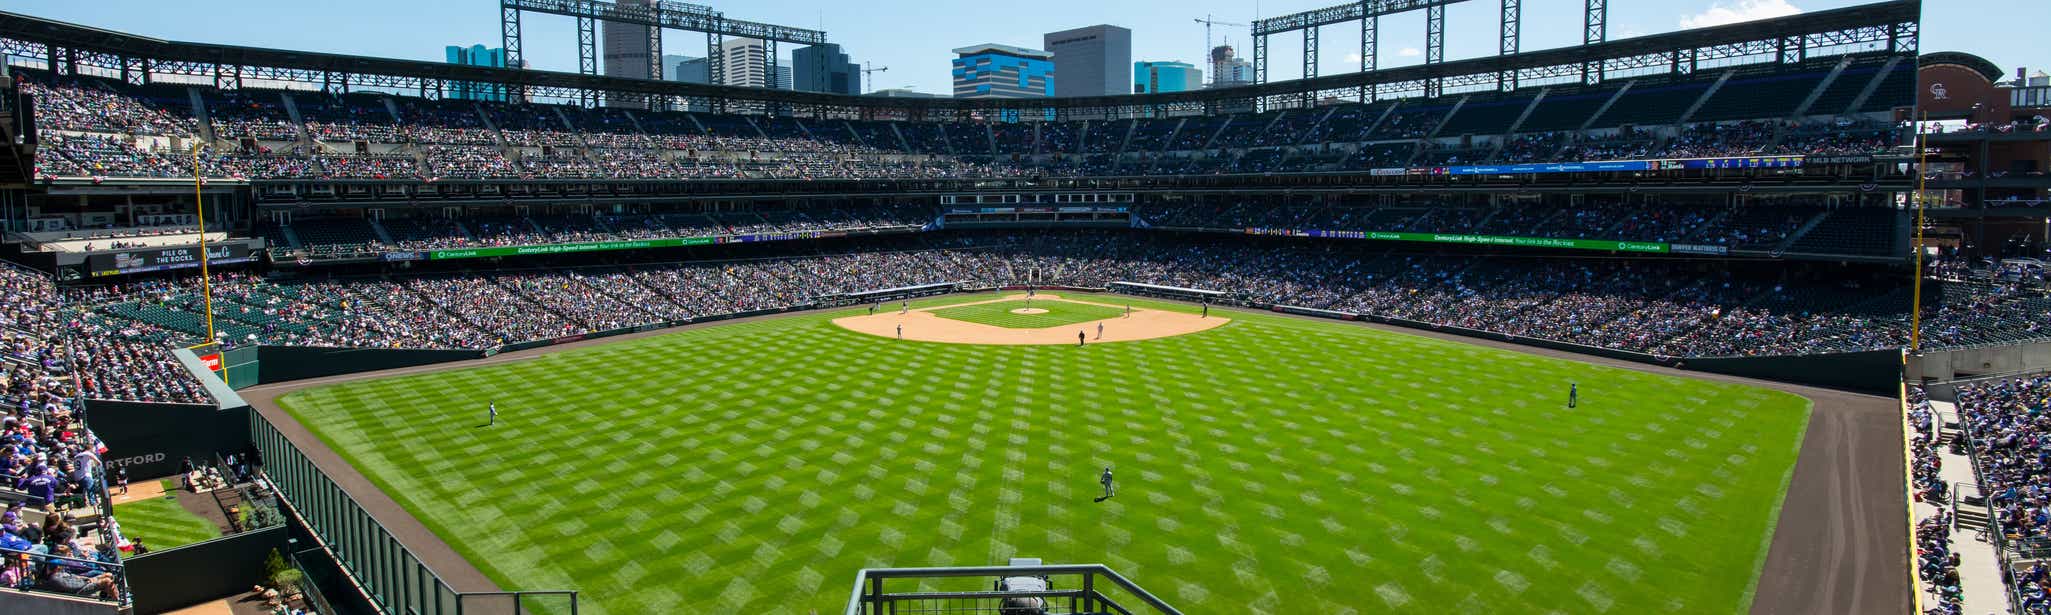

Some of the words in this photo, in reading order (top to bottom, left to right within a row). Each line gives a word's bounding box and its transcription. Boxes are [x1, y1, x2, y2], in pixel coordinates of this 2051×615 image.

[1434, 234, 1462, 242] CenturyLink
[518, 246, 548, 254] CenturyLink
[105, 453, 166, 470] RTFORD
